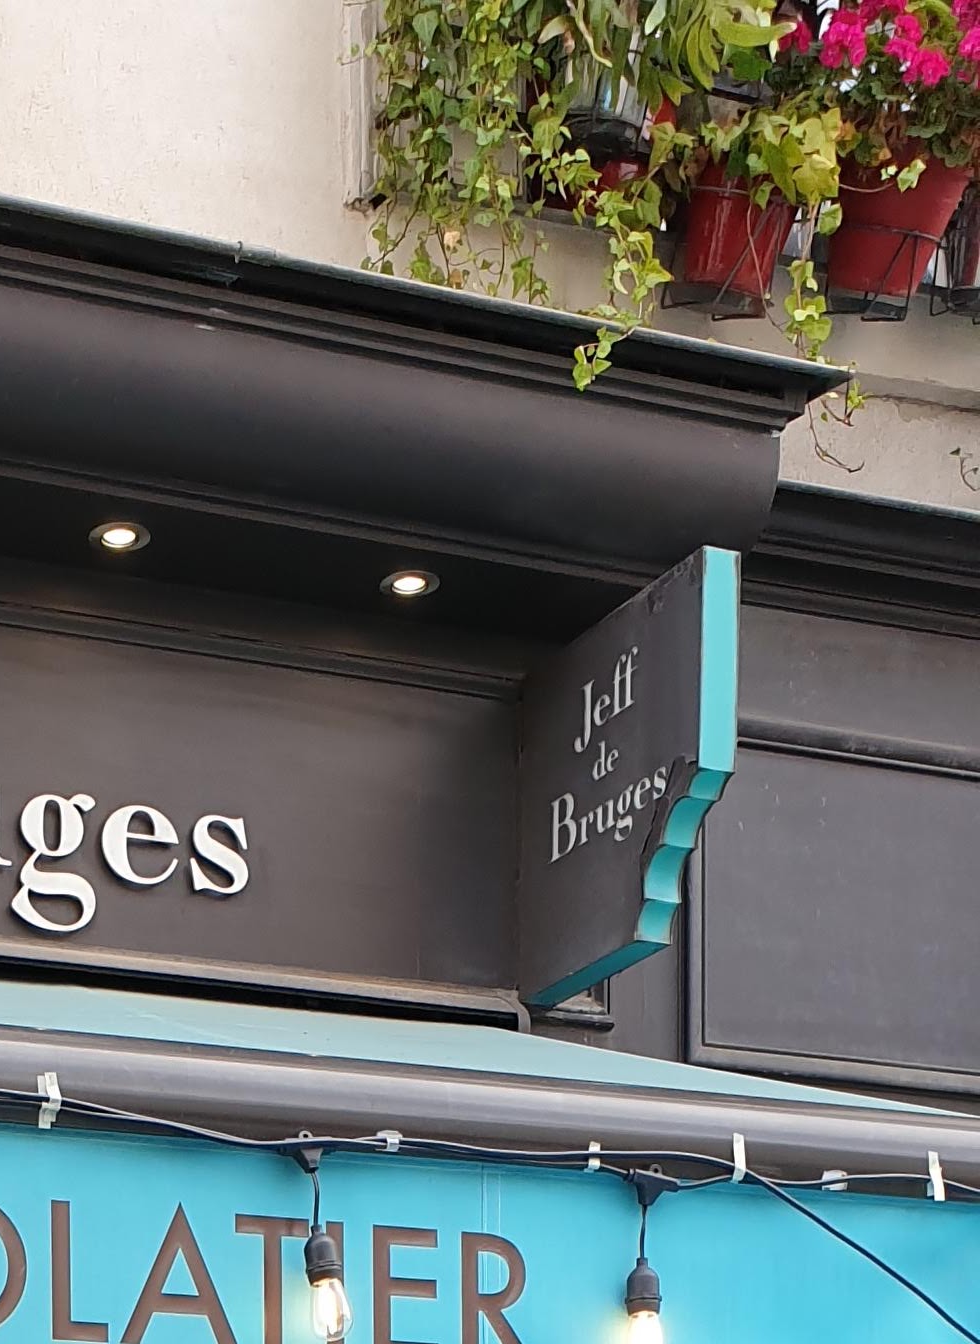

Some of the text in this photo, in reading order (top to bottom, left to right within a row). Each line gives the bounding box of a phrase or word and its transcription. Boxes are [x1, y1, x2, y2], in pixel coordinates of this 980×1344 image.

[573, 644, 642, 755] Jeff
[591, 740, 619, 783] de
[548, 763, 668, 864] Bruges
